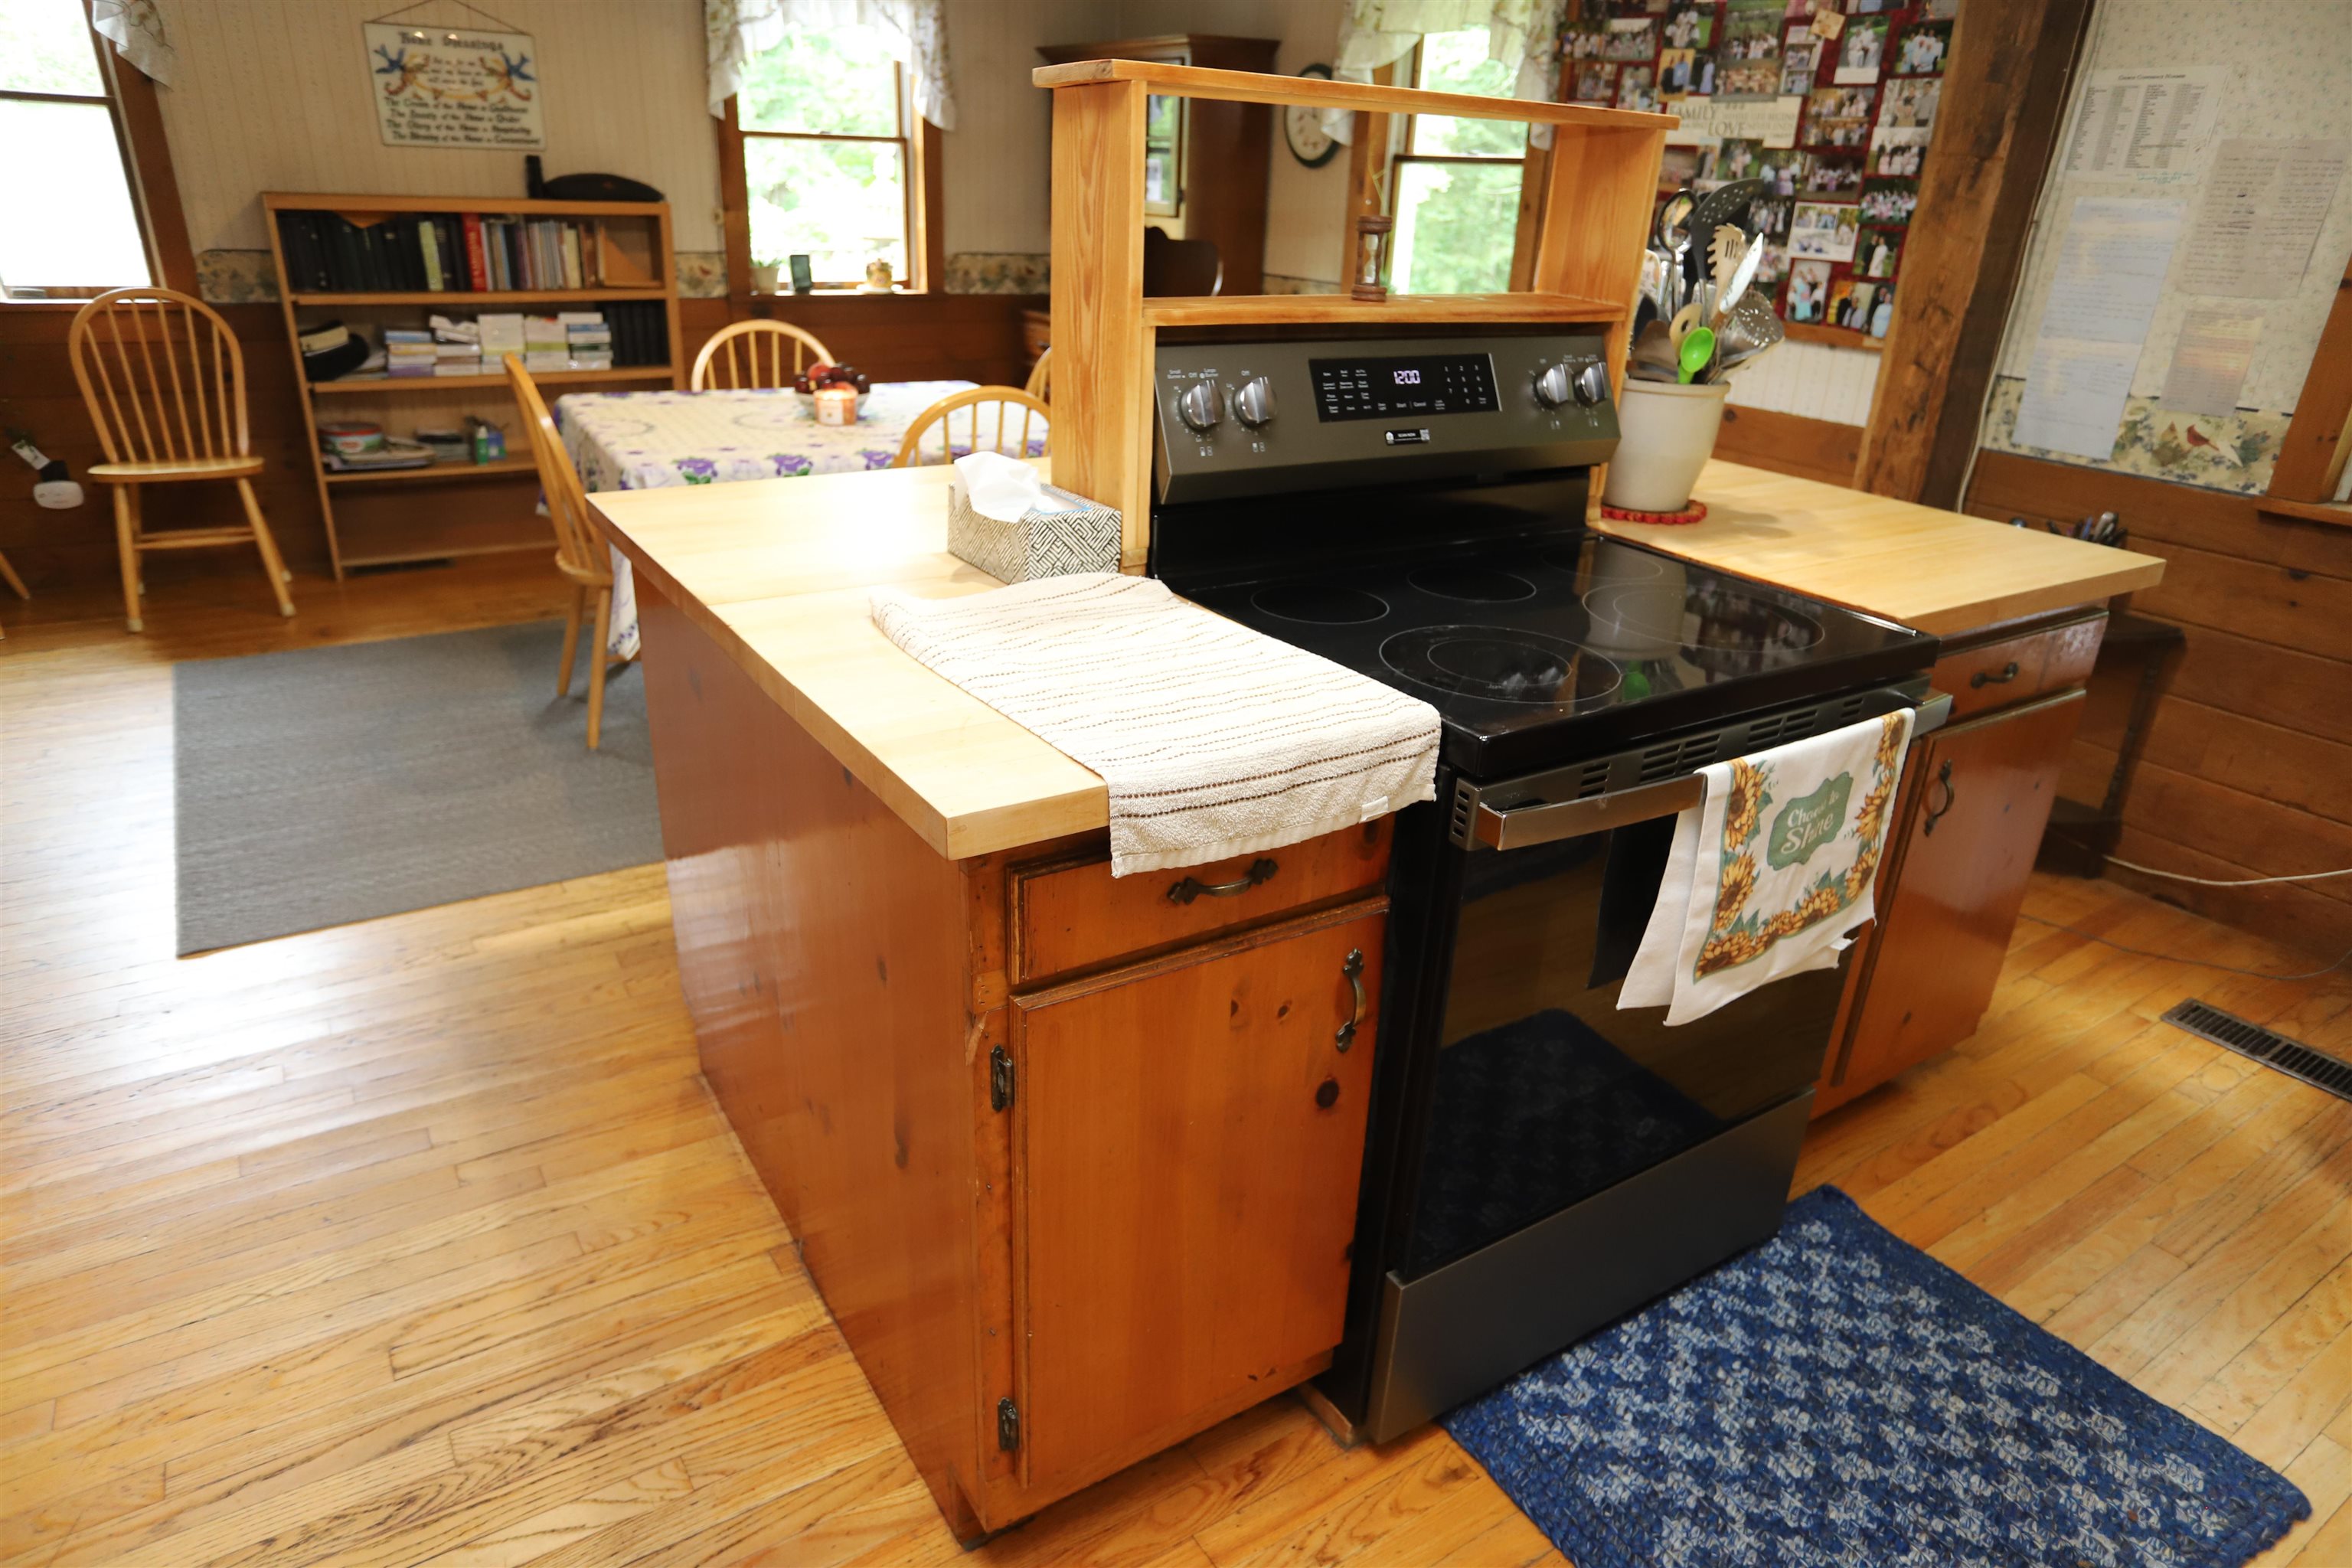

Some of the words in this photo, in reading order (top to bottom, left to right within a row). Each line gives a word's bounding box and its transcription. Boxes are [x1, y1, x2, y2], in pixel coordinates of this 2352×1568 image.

[1708, 121, 1746, 137] LOVE
[1828, 789, 1839, 805] to
[1781, 813, 1834, 854] Shine
